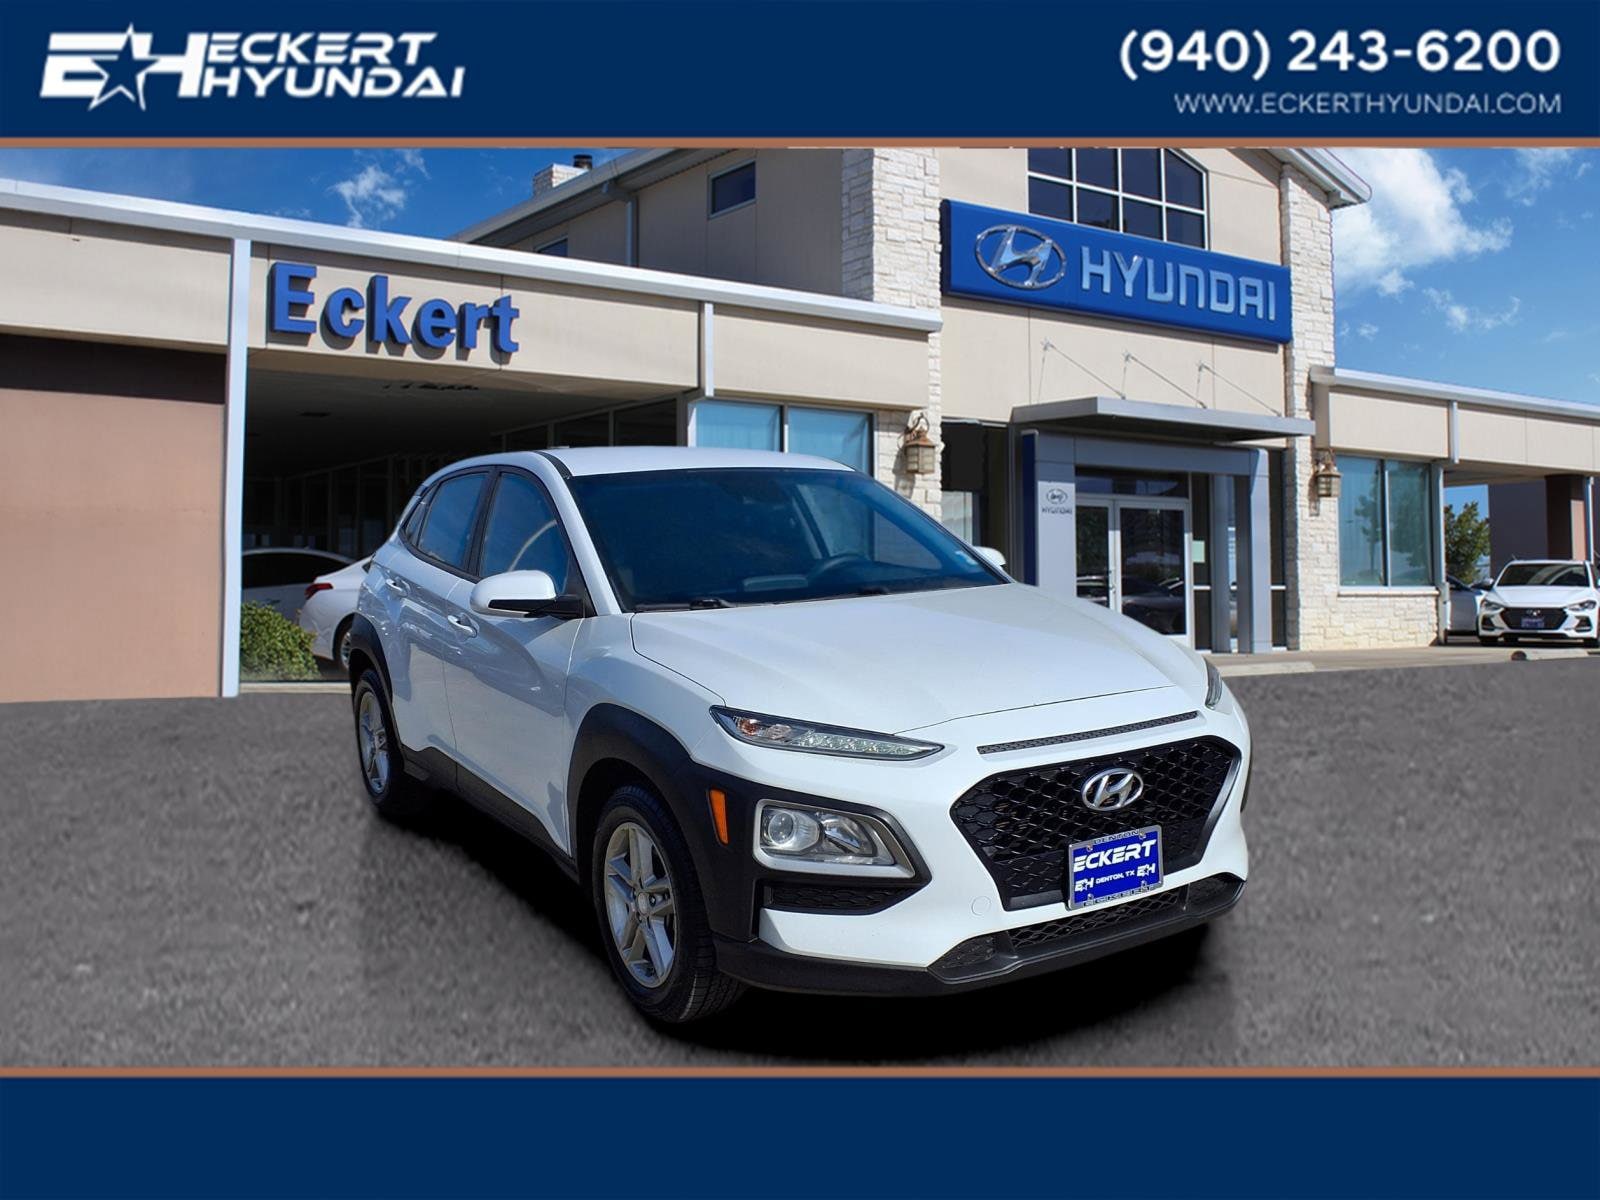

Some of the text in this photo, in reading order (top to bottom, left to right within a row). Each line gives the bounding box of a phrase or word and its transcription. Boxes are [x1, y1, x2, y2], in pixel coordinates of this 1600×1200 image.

[1080, 246, 1276, 322] HYUNDAI
[268, 261, 520, 354] Eckert
[1094, 829, 1140, 845] DENTON
[1073, 839, 1157, 873] ECKERT
[1125, 869, 1135, 878] TX
